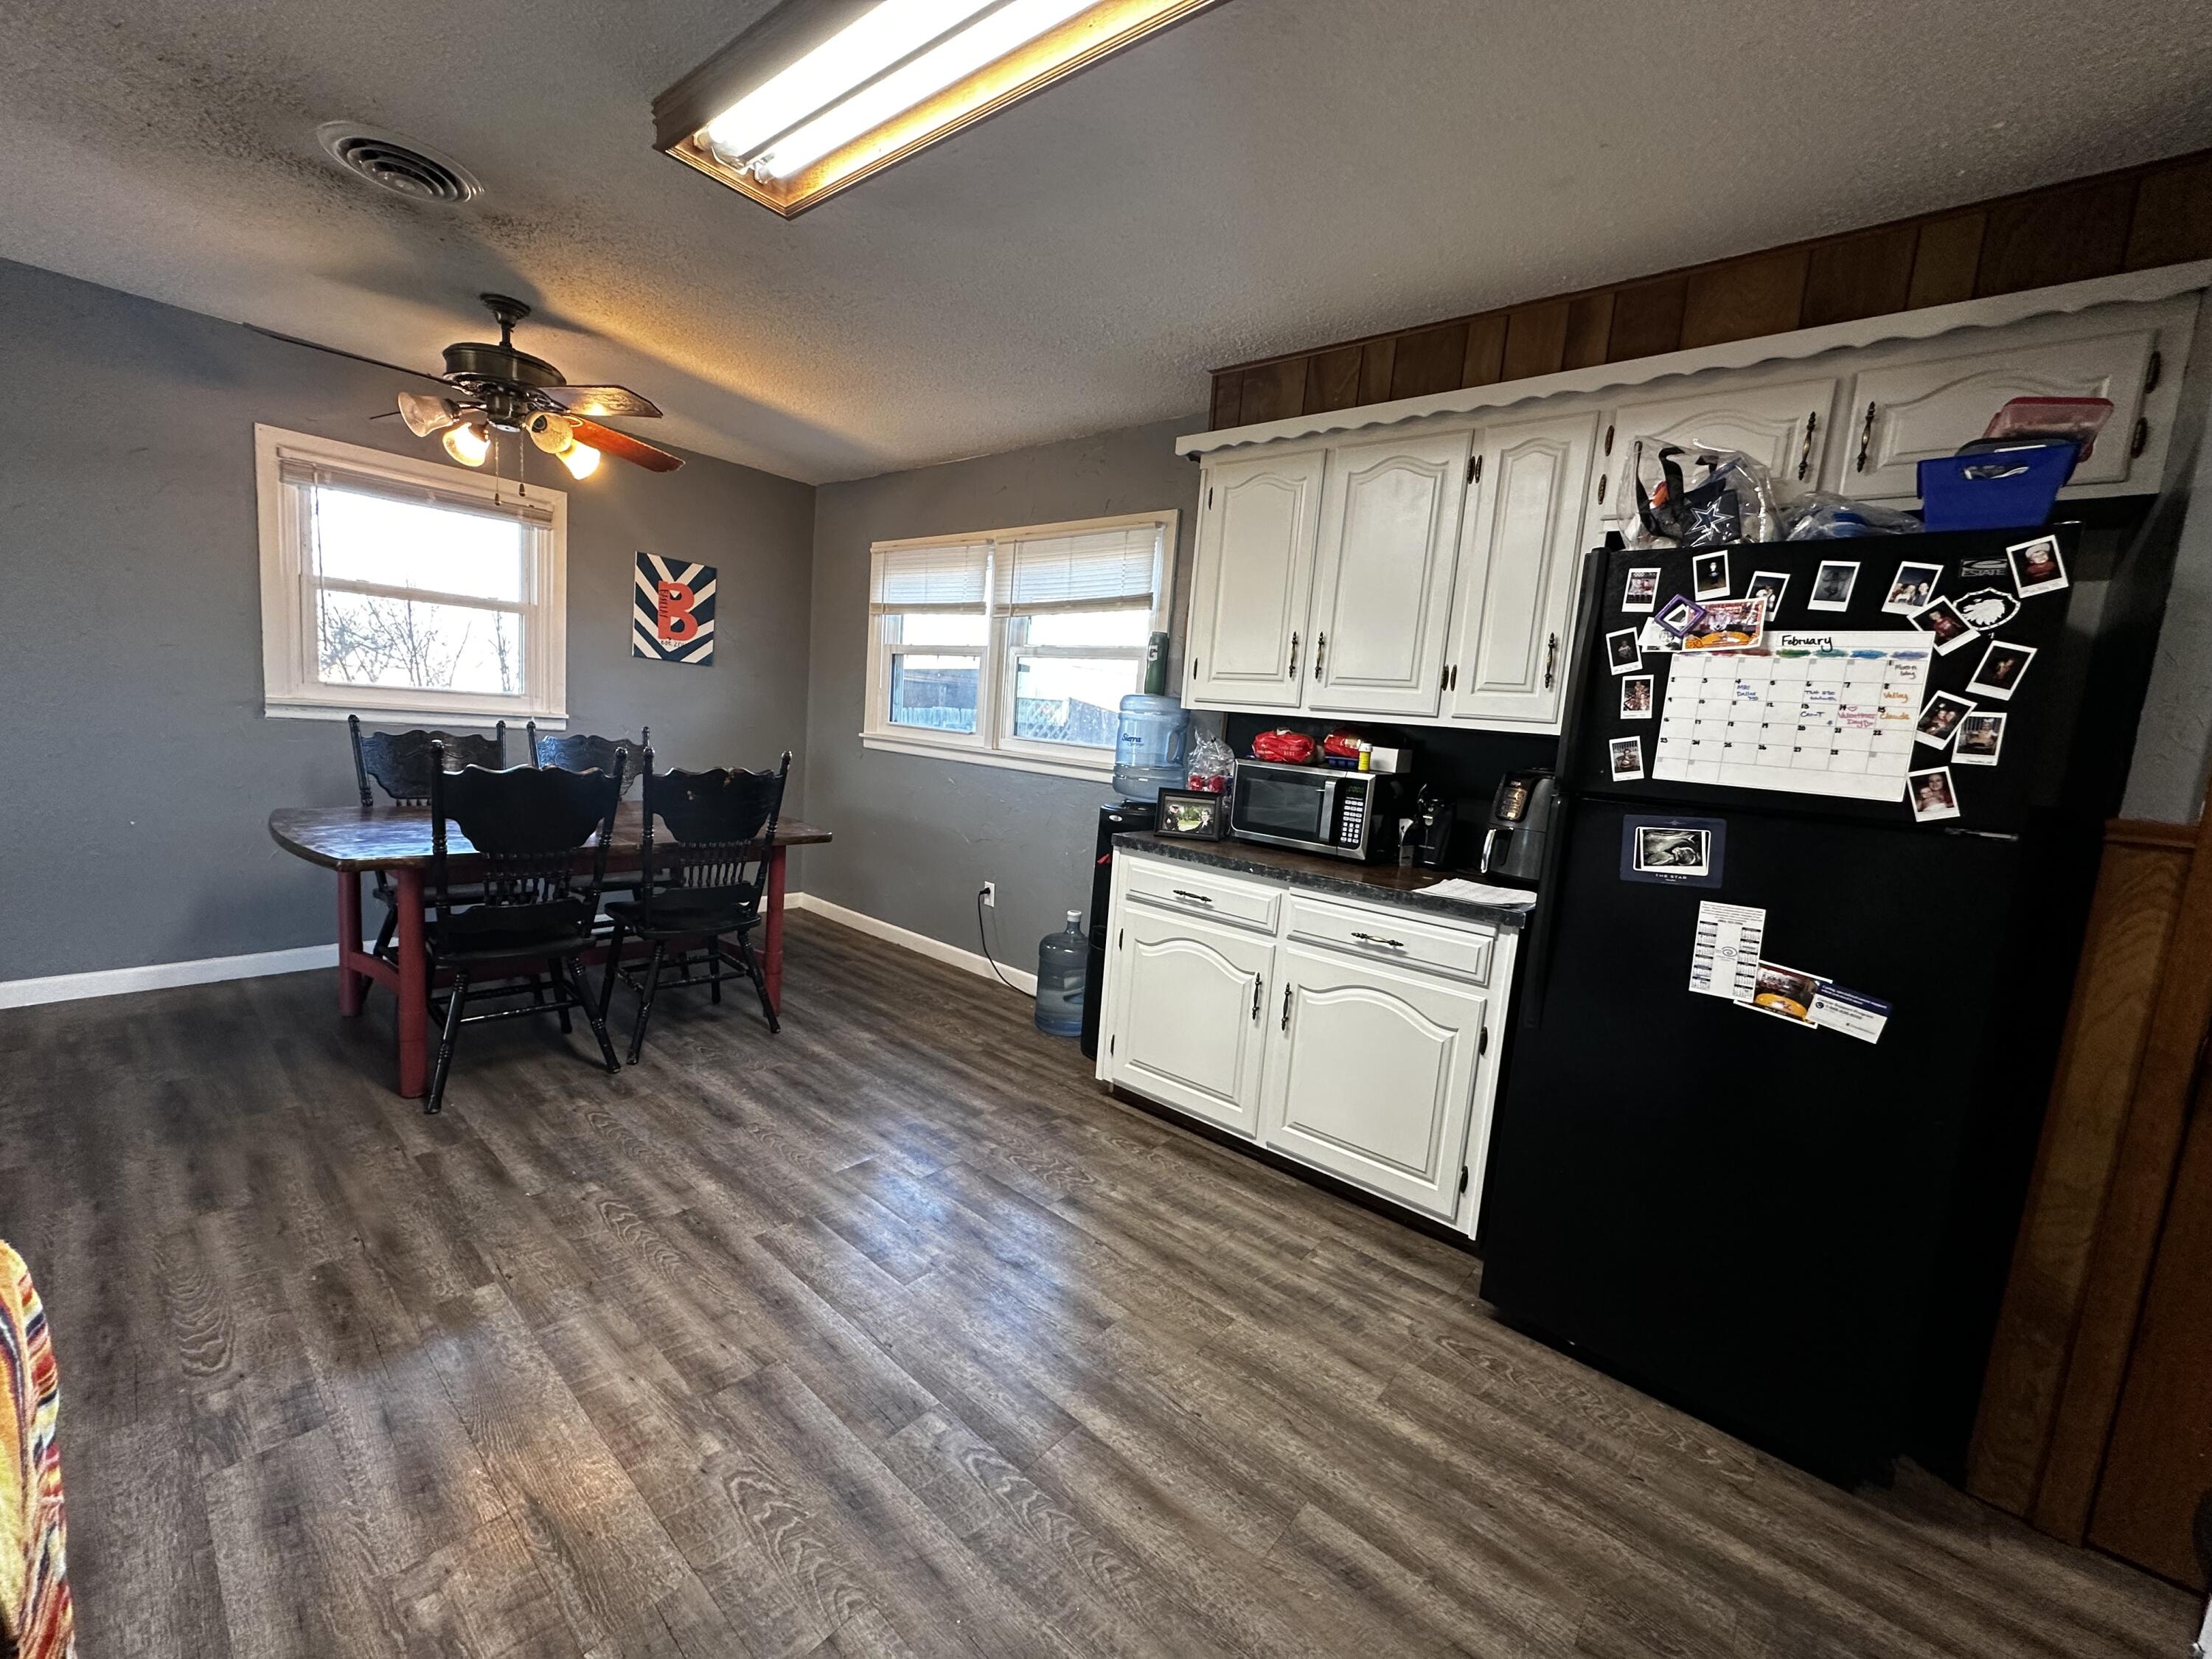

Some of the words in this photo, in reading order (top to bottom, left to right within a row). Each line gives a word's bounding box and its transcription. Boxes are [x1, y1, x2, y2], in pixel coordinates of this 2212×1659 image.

[1961, 568, 2006, 577] ESTATE
[658, 580, 698, 641] B
[1781, 635, 1833, 653] February
[1121, 733, 1142, 742] Sierra
